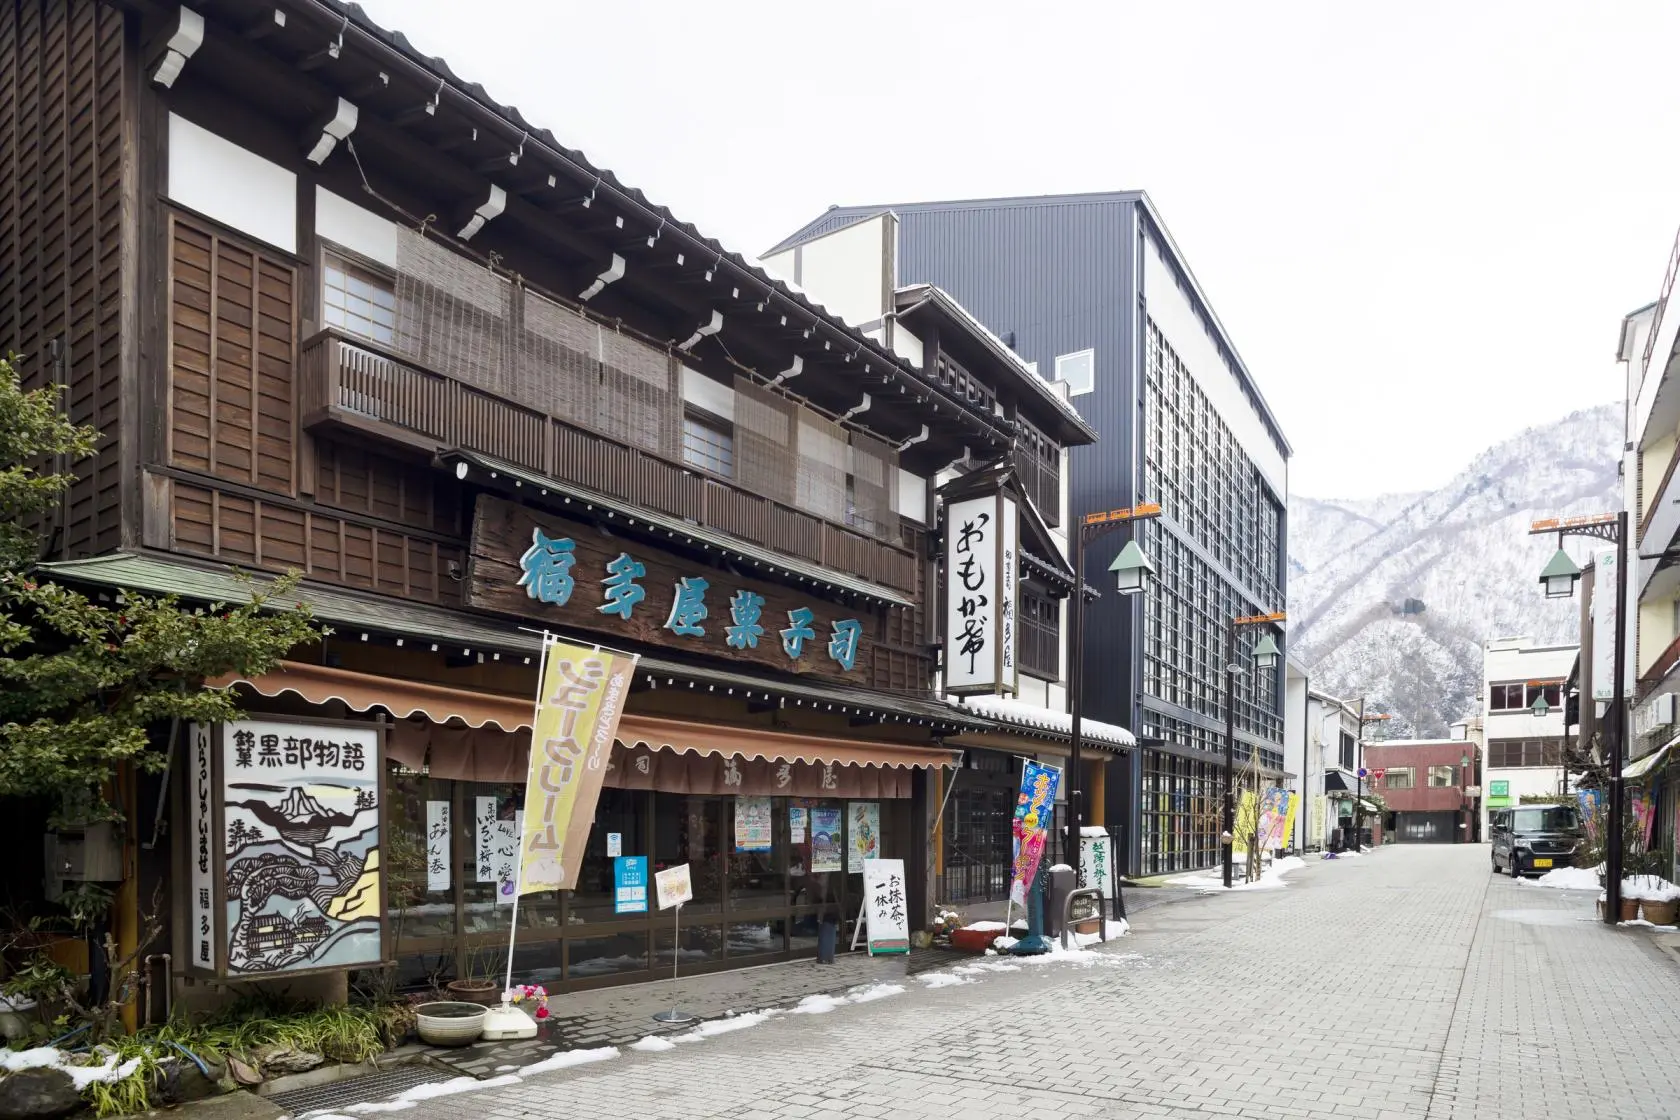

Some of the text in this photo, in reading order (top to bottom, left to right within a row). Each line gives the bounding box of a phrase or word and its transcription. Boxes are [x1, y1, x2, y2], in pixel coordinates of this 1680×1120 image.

[516, 527, 863, 672] 福多屋菓子司
[232, 729, 365, 772] 銘菓 黒部物語
[723, 759, 837, 789] 福多屋
[197, 731, 210, 964] いらっしゃいませ 福多屋
[428, 823, 446, 874] あん巻
[498, 823, 514, 838] LOVE
[874, 882, 889, 918] 一休み
[888, 874, 905, 931] お抹茶で
